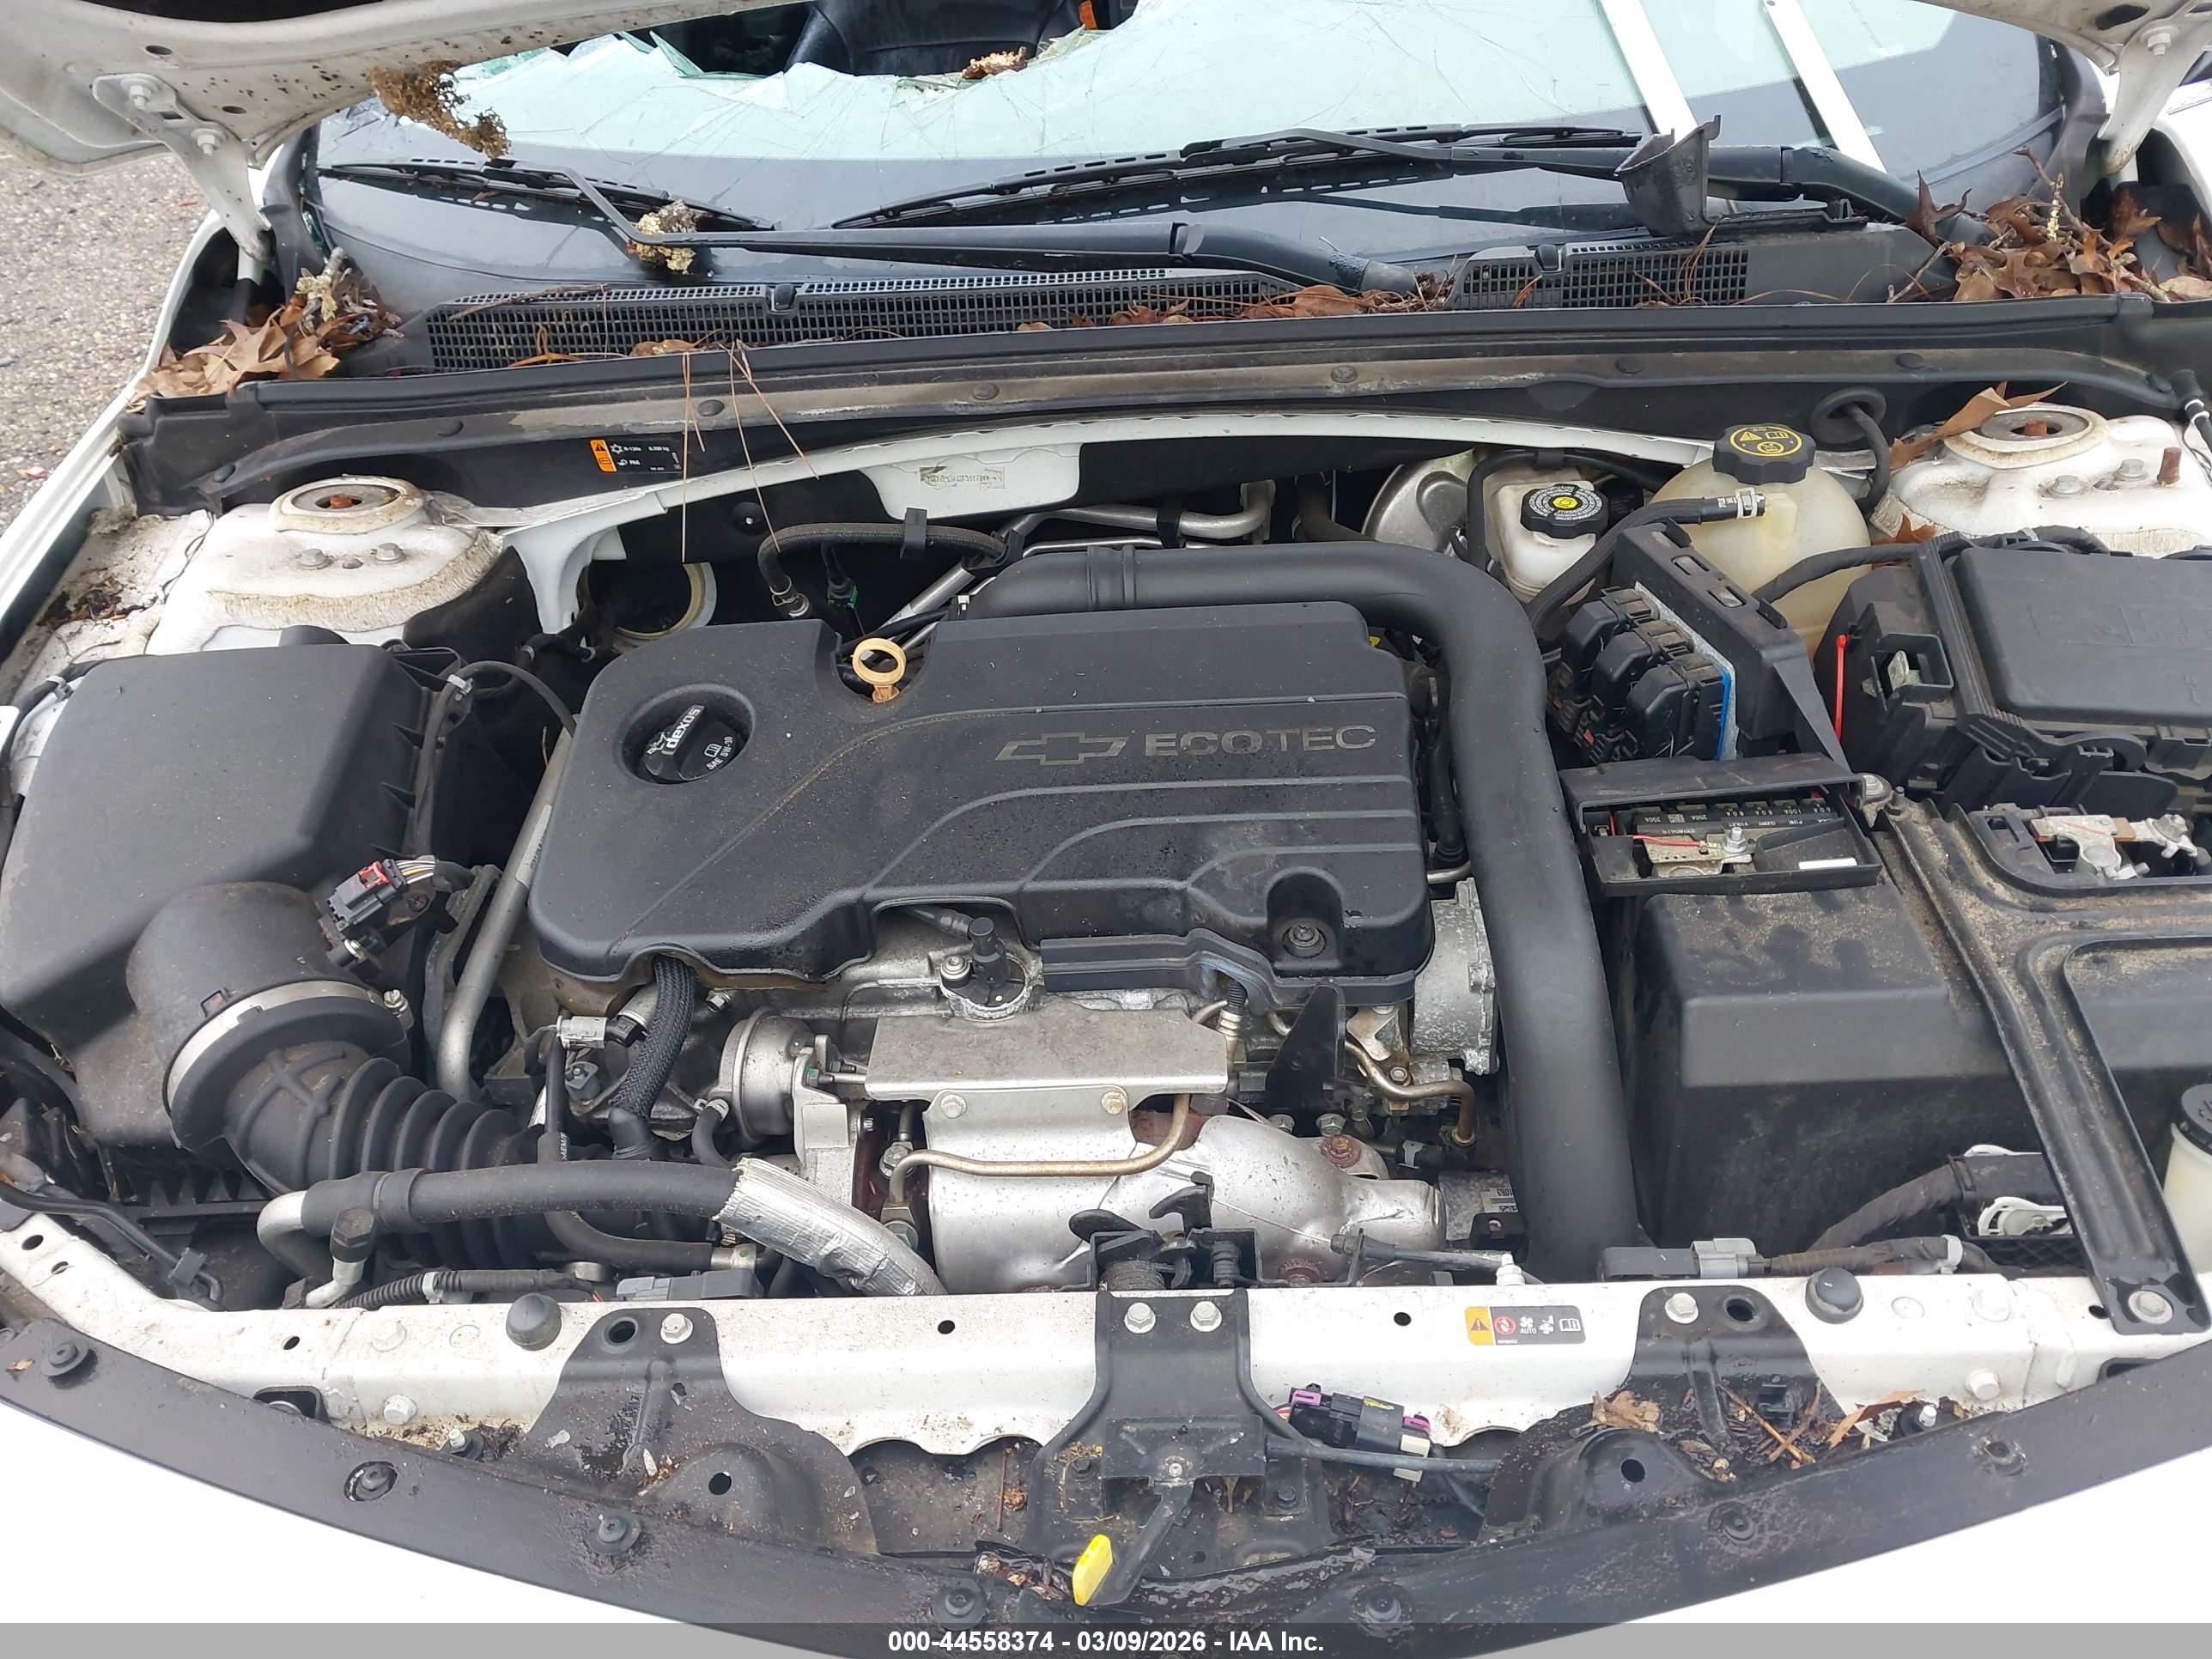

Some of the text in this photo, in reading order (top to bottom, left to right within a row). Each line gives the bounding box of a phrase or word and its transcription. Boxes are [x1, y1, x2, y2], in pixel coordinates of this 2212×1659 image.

[666, 708, 701, 749] dexos
[1145, 724, 1376, 757] ECOTEC
[720, 737, 734, 757] 5W-30
[707, 758, 723, 770] SAE
